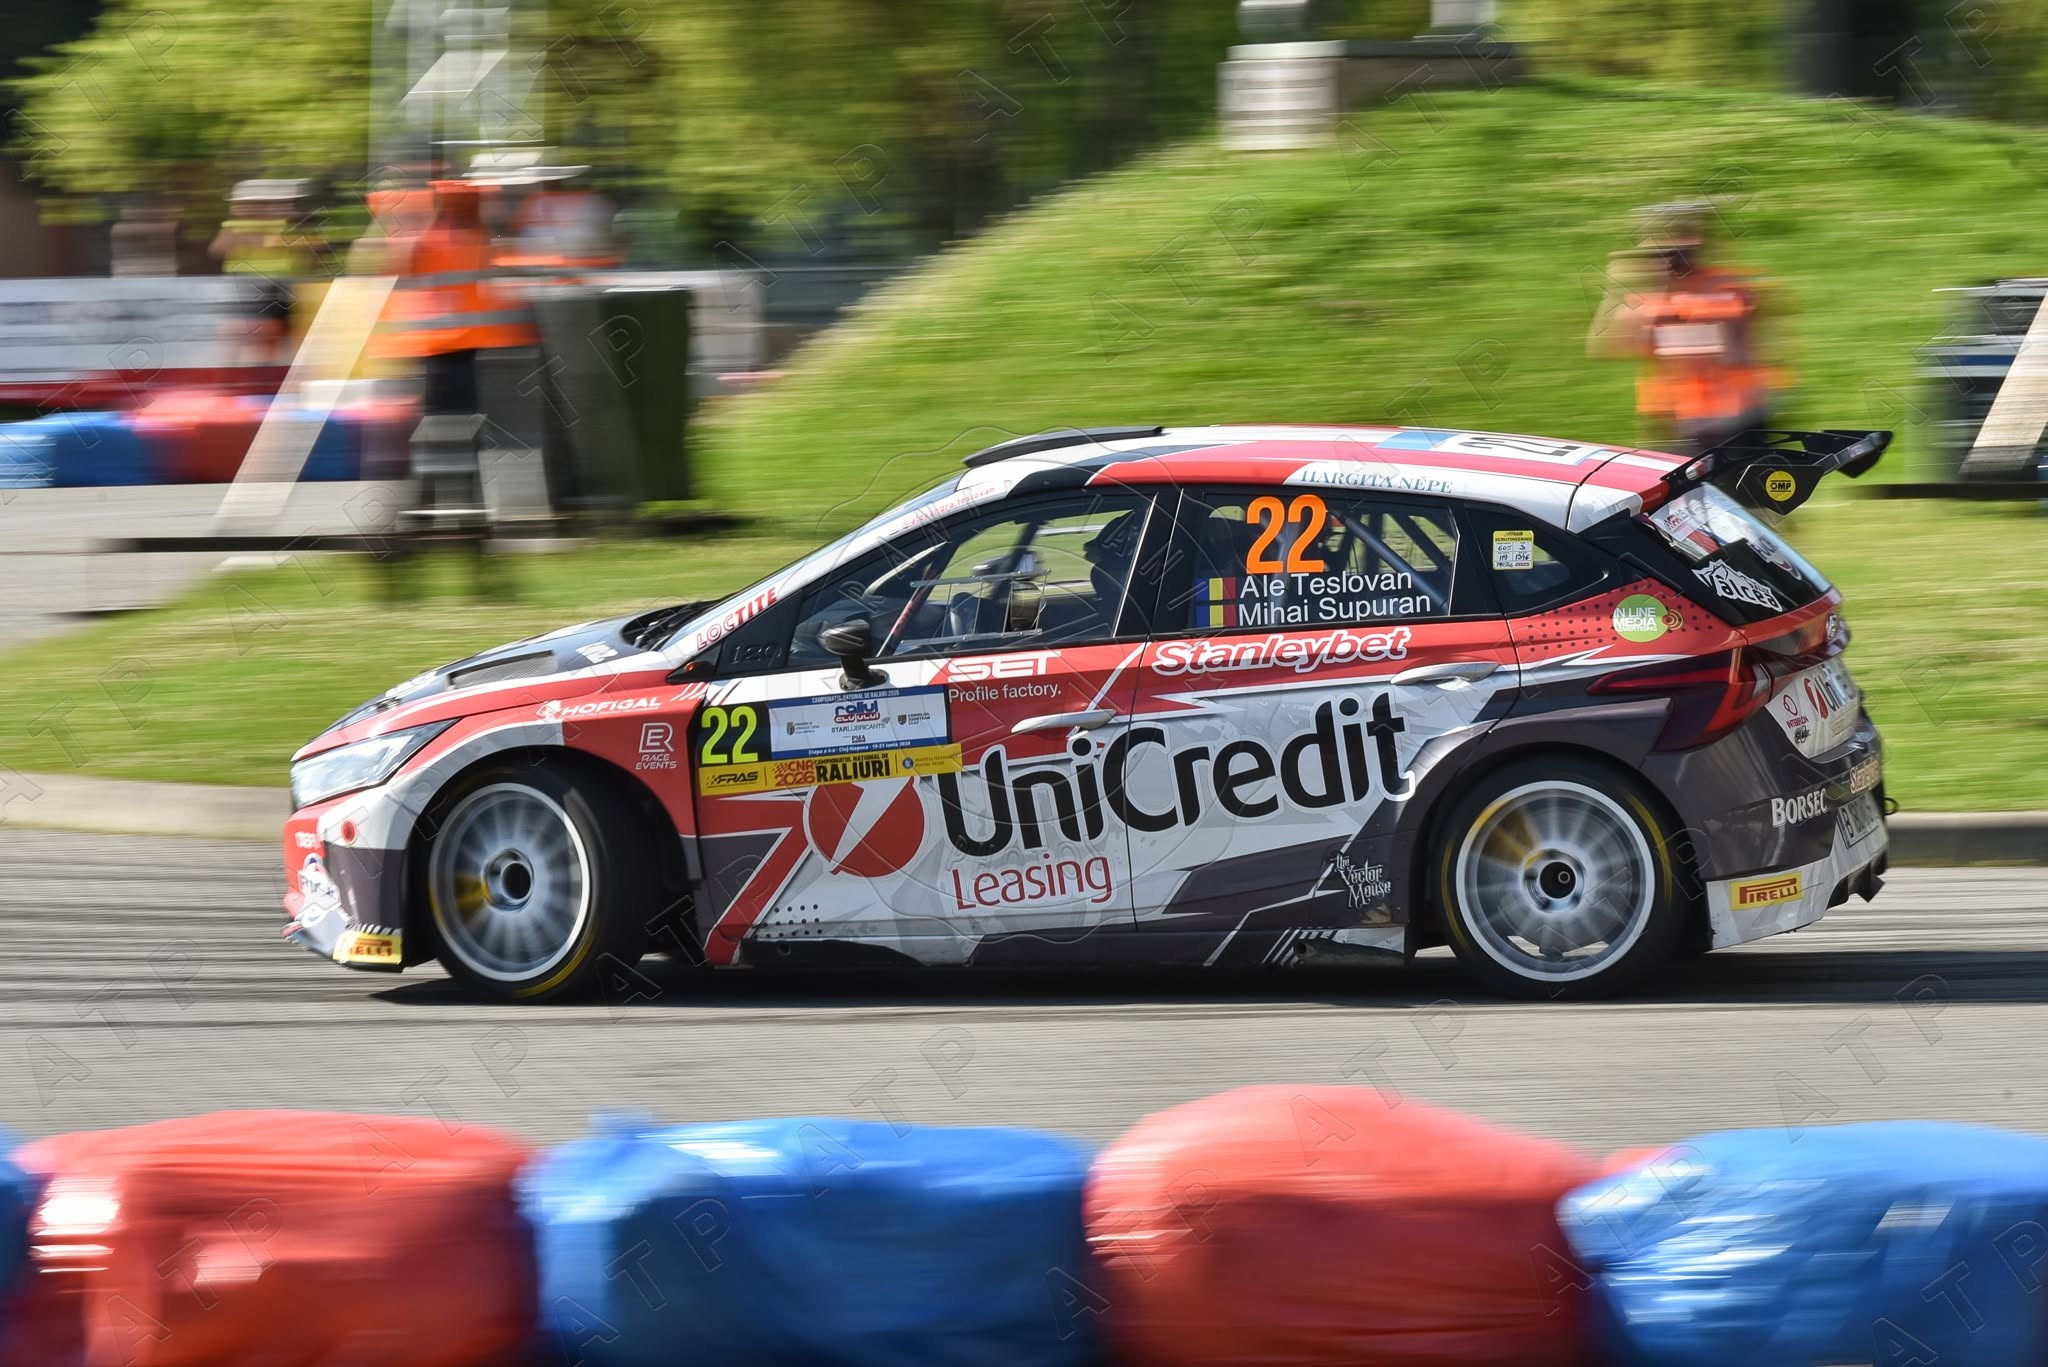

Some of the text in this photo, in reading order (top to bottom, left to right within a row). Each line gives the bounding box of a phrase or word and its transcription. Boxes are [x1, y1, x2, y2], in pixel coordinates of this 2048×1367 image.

[1302, 470, 1454, 493] HARGITA NÉPE
[1770, 482, 1792, 491] OMP
[1246, 494, 1328, 574] 22
[1240, 571, 1413, 598] Ale Teslovan
[696, 586, 777, 651] LOCTITE
[1238, 594, 1432, 627] Mihai Supuran
[1613, 617, 1657, 627] MEDIA
[1629, 607, 1656, 618] LINE
[1151, 626, 1412, 676] Stanleybet
[946, 651, 1062, 682] SET
[947, 681, 1062, 704] Profile factory.
[561, 696, 663, 717] HOFIGAL
[701, 706, 760, 765] 22
[635, 760, 678, 770] EVENTS
[641, 753, 671, 763] RACE
[788, 760, 815, 772] CNR
[717, 759, 891, 787] FRAS 2026 RALIURI
[938, 692, 1410, 857] UniCredit
[1771, 788, 1828, 828] BORSEC
[951, 853, 1113, 911] Leasing
[1340, 859, 1384, 886] Vector
[1348, 881, 1392, 909] Mouse
[1739, 878, 1798, 904] PIRELLI
